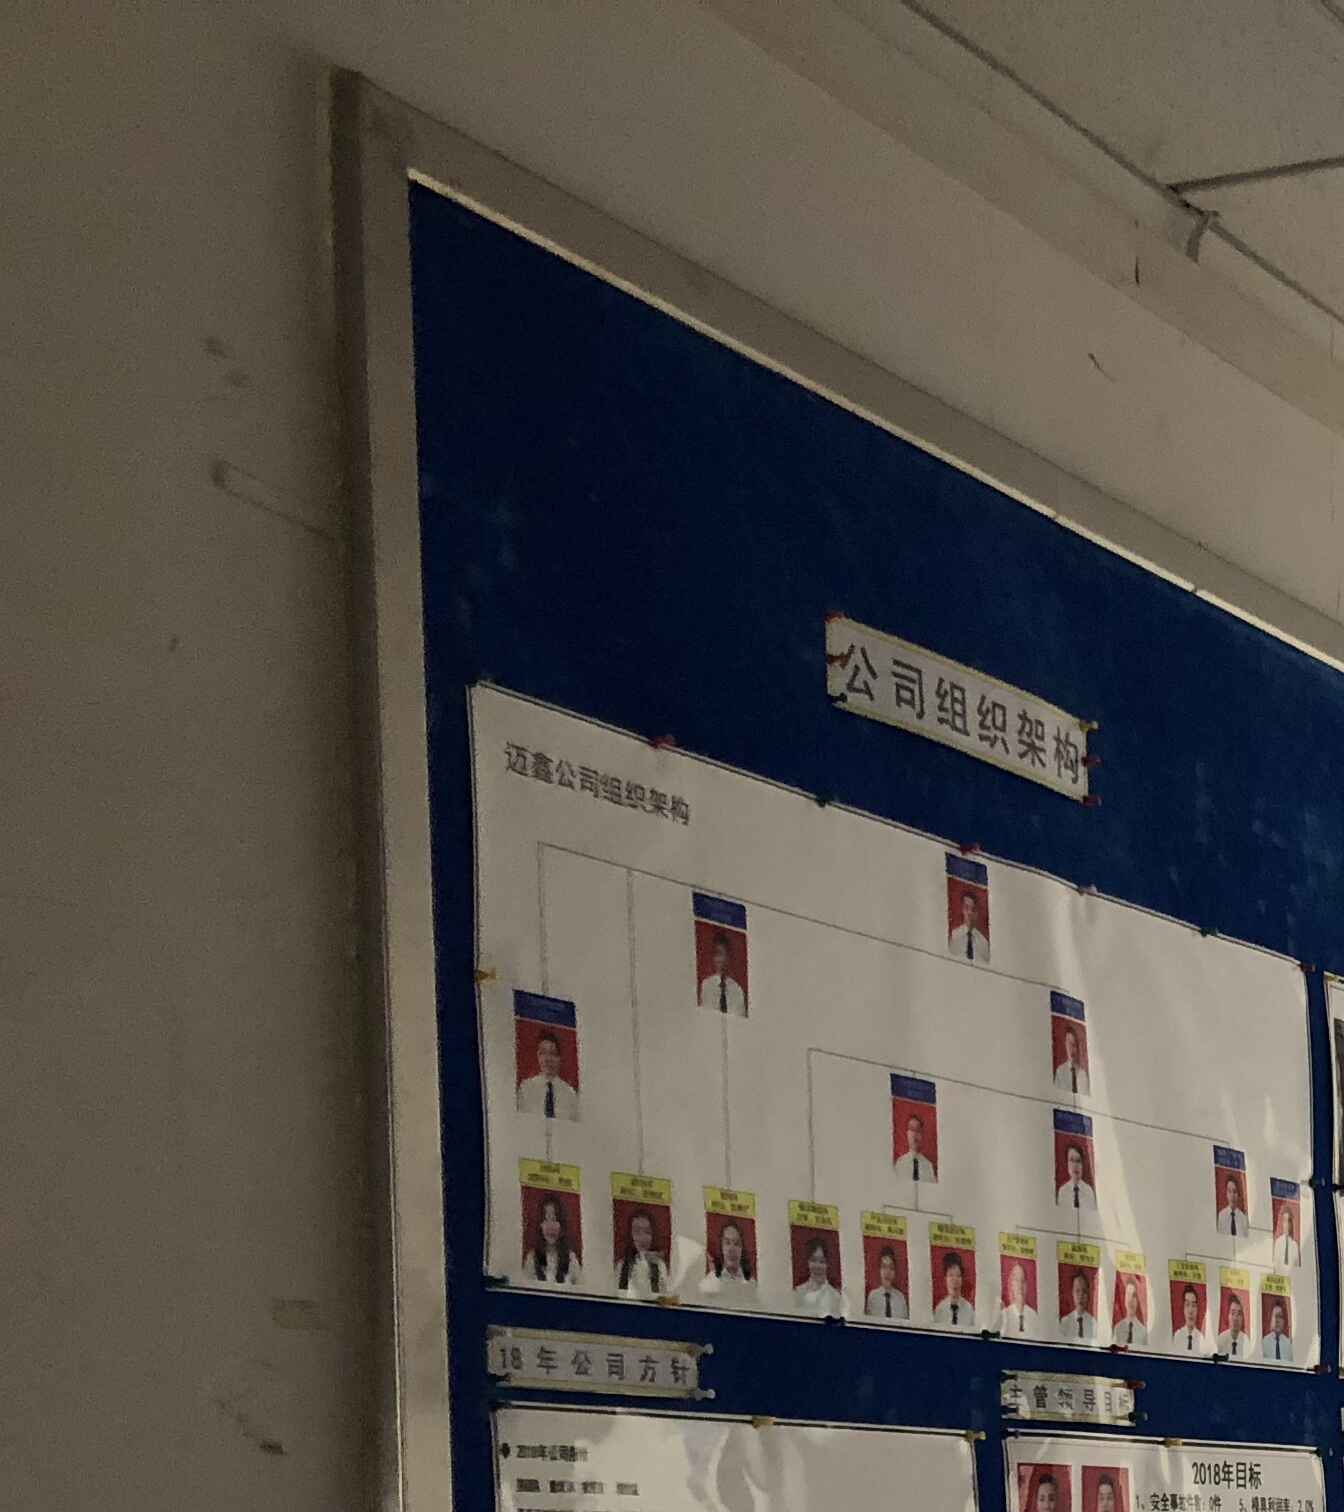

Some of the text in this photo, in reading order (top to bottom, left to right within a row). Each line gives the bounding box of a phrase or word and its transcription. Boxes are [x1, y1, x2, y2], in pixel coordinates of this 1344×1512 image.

[840, 641, 1083, 788] 公司组织架构
[504, 741, 693, 827] 迈鑫公司组织架构
[500, 1345, 691, 1385] 18年公司方针
[1192, 1461, 1262, 1490] 2018年目标
